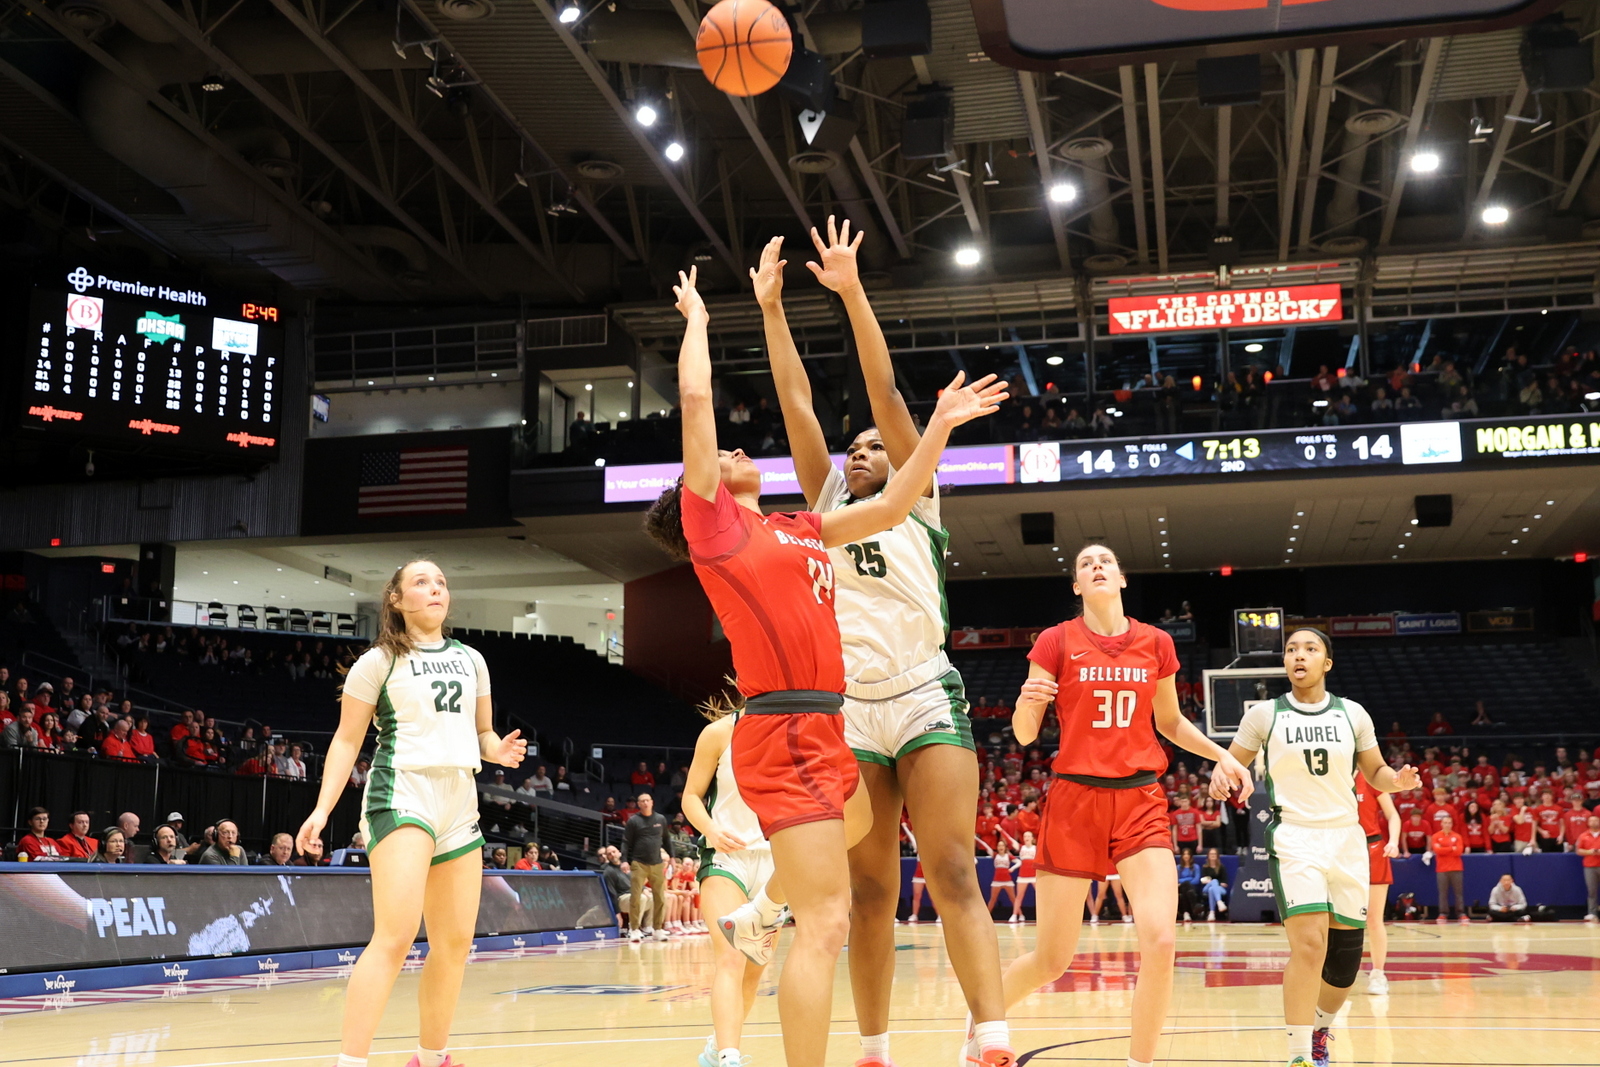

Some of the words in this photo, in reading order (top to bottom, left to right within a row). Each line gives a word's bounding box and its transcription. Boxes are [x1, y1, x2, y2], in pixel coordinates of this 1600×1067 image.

[98, 276, 154, 297] Premier
[159, 286, 206, 306] Health
[1158, 296, 1196, 310] THE
[1206, 290, 1290, 306] CONNOR
[242, 303, 278, 322] 12:49
[1130, 304, 1235, 330] FLIGHT
[1242, 300, 1321, 323] DECK
[67, 326, 75, 336] P
[94, 331, 103, 342] R
[117, 334, 126, 345] A
[144, 338, 152, 348] F
[137, 318, 186, 341] OHSAA
[66, 341, 74, 350] 0
[92, 345, 98, 354] 1
[115, 348, 121, 357] 1
[138, 352, 146, 361] 0
[196, 346, 204, 356] P
[221, 350, 229, 361] R
[243, 354, 251, 364] A
[268, 357, 275, 367] F
[37, 359, 51, 370] 14
[65, 363, 73, 373] 0
[114, 371, 122, 380] 0
[136, 374, 144, 383] 0
[66, 352, 73, 361] 0
[91, 356, 99, 365] 0
[115, 359, 122, 368] 0
[137, 362, 144, 372] 0
[172, 357, 177, 366] 1
[197, 361, 205, 370] 0
[220, 365, 228, 373] 4
[243, 368, 250, 377] 0
[265, 371, 272, 380] 0
[89, 378, 97, 387] 0
[113, 382, 120, 391] 0
[136, 384, 143, 394] 0
[169, 368, 182, 378] 13
[197, 372, 204, 380] 0
[220, 375, 227, 384] 0
[243, 379, 250, 388] 0
[265, 381, 272, 390] 0
[35, 381, 50, 392] 30
[63, 385, 71, 394] 4
[135, 395, 141, 404] 1
[196, 383, 204, 392] 0
[220, 386, 227, 395] 0
[242, 389, 247, 398] 1
[264, 392, 271, 401] 0
[195, 404, 202, 413] 4
[218, 407, 224, 416] 1
[241, 410, 248, 419] 0
[263, 413, 270, 422] 0
[264, 403, 271, 412] 0
[1352, 435, 1393, 460] 14
[1476, 424, 1565, 453] MORGAN
[1569, 423, 1587, 448] &
[1203, 438, 1260, 460] 7:13
[1304, 445, 1316, 460] 0
[1325, 444, 1337, 459] 5
[1077, 450, 1116, 474] 14
[1128, 455, 1139, 469] 5
[1149, 453, 1160, 468] 0
[1221, 461, 1245, 472] 2ND
[606, 480, 615, 490] Is
[616, 479, 637, 489] Your
[639, 478, 663, 488] Child
[844, 541, 887, 578] 25
[807, 556, 833, 604] 14
[1398, 620, 1425, 629] SAINT
[1430, 618, 1458, 627] LOUIS
[410, 660, 469, 676] LAUREL
[1079, 666, 1148, 683] BELLEVUE
[431, 680, 462, 713] 22
[1092, 690, 1136, 728] 30
[1286, 726, 1341, 744] LAUREL
[1303, 748, 1328, 776] 13
[90, 897, 177, 938] PEAT.
[172, 964, 189, 980] Kroger
[53, 975, 76, 992] Kroger
